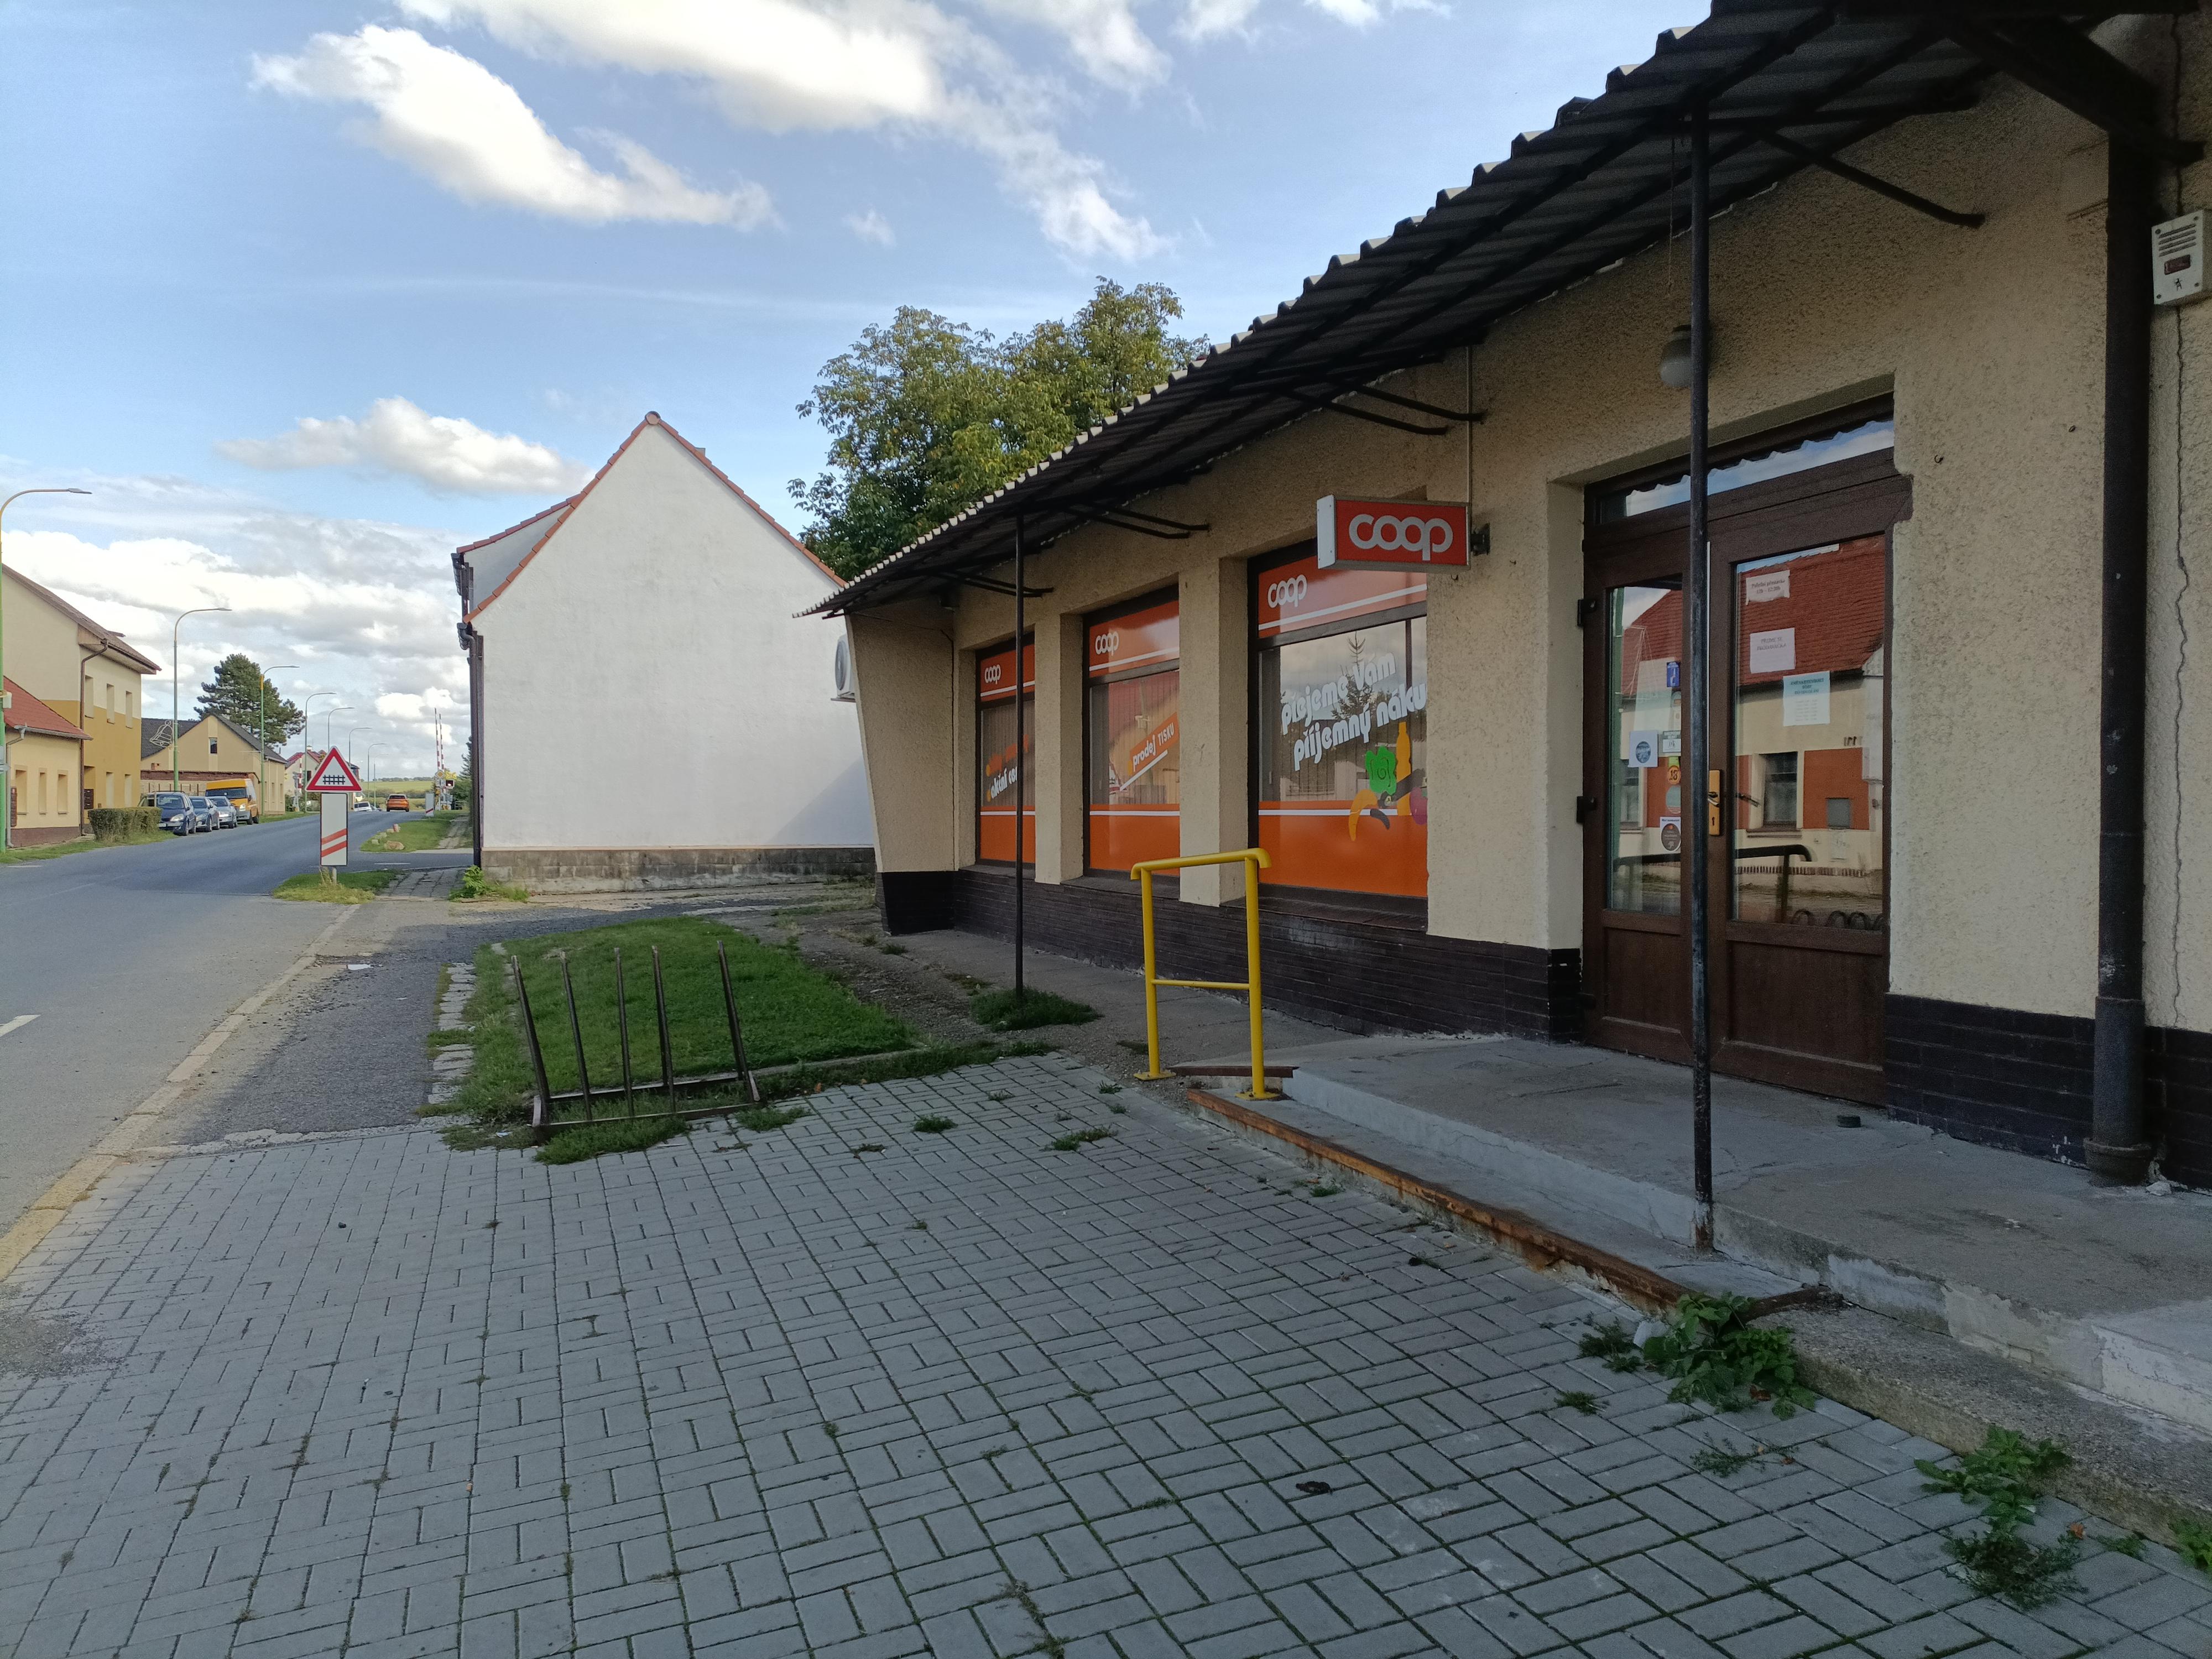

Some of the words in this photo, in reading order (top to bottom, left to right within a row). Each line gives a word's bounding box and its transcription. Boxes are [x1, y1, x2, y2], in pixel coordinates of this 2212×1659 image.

[1349, 514, 1453, 561] coop
[1267, 574, 1307, 608] coop
[1095, 631, 1119, 656] coop
[984, 664, 1001, 685] coop
[1353, 652, 1396, 691] Vám
[1294, 702, 1371, 771] příjemný
[1376, 683, 1426, 727] náku
[1133, 734, 1156, 772] prodej
[1157, 722, 1175, 746] TISKU
[991, 767, 1008, 799] akční
